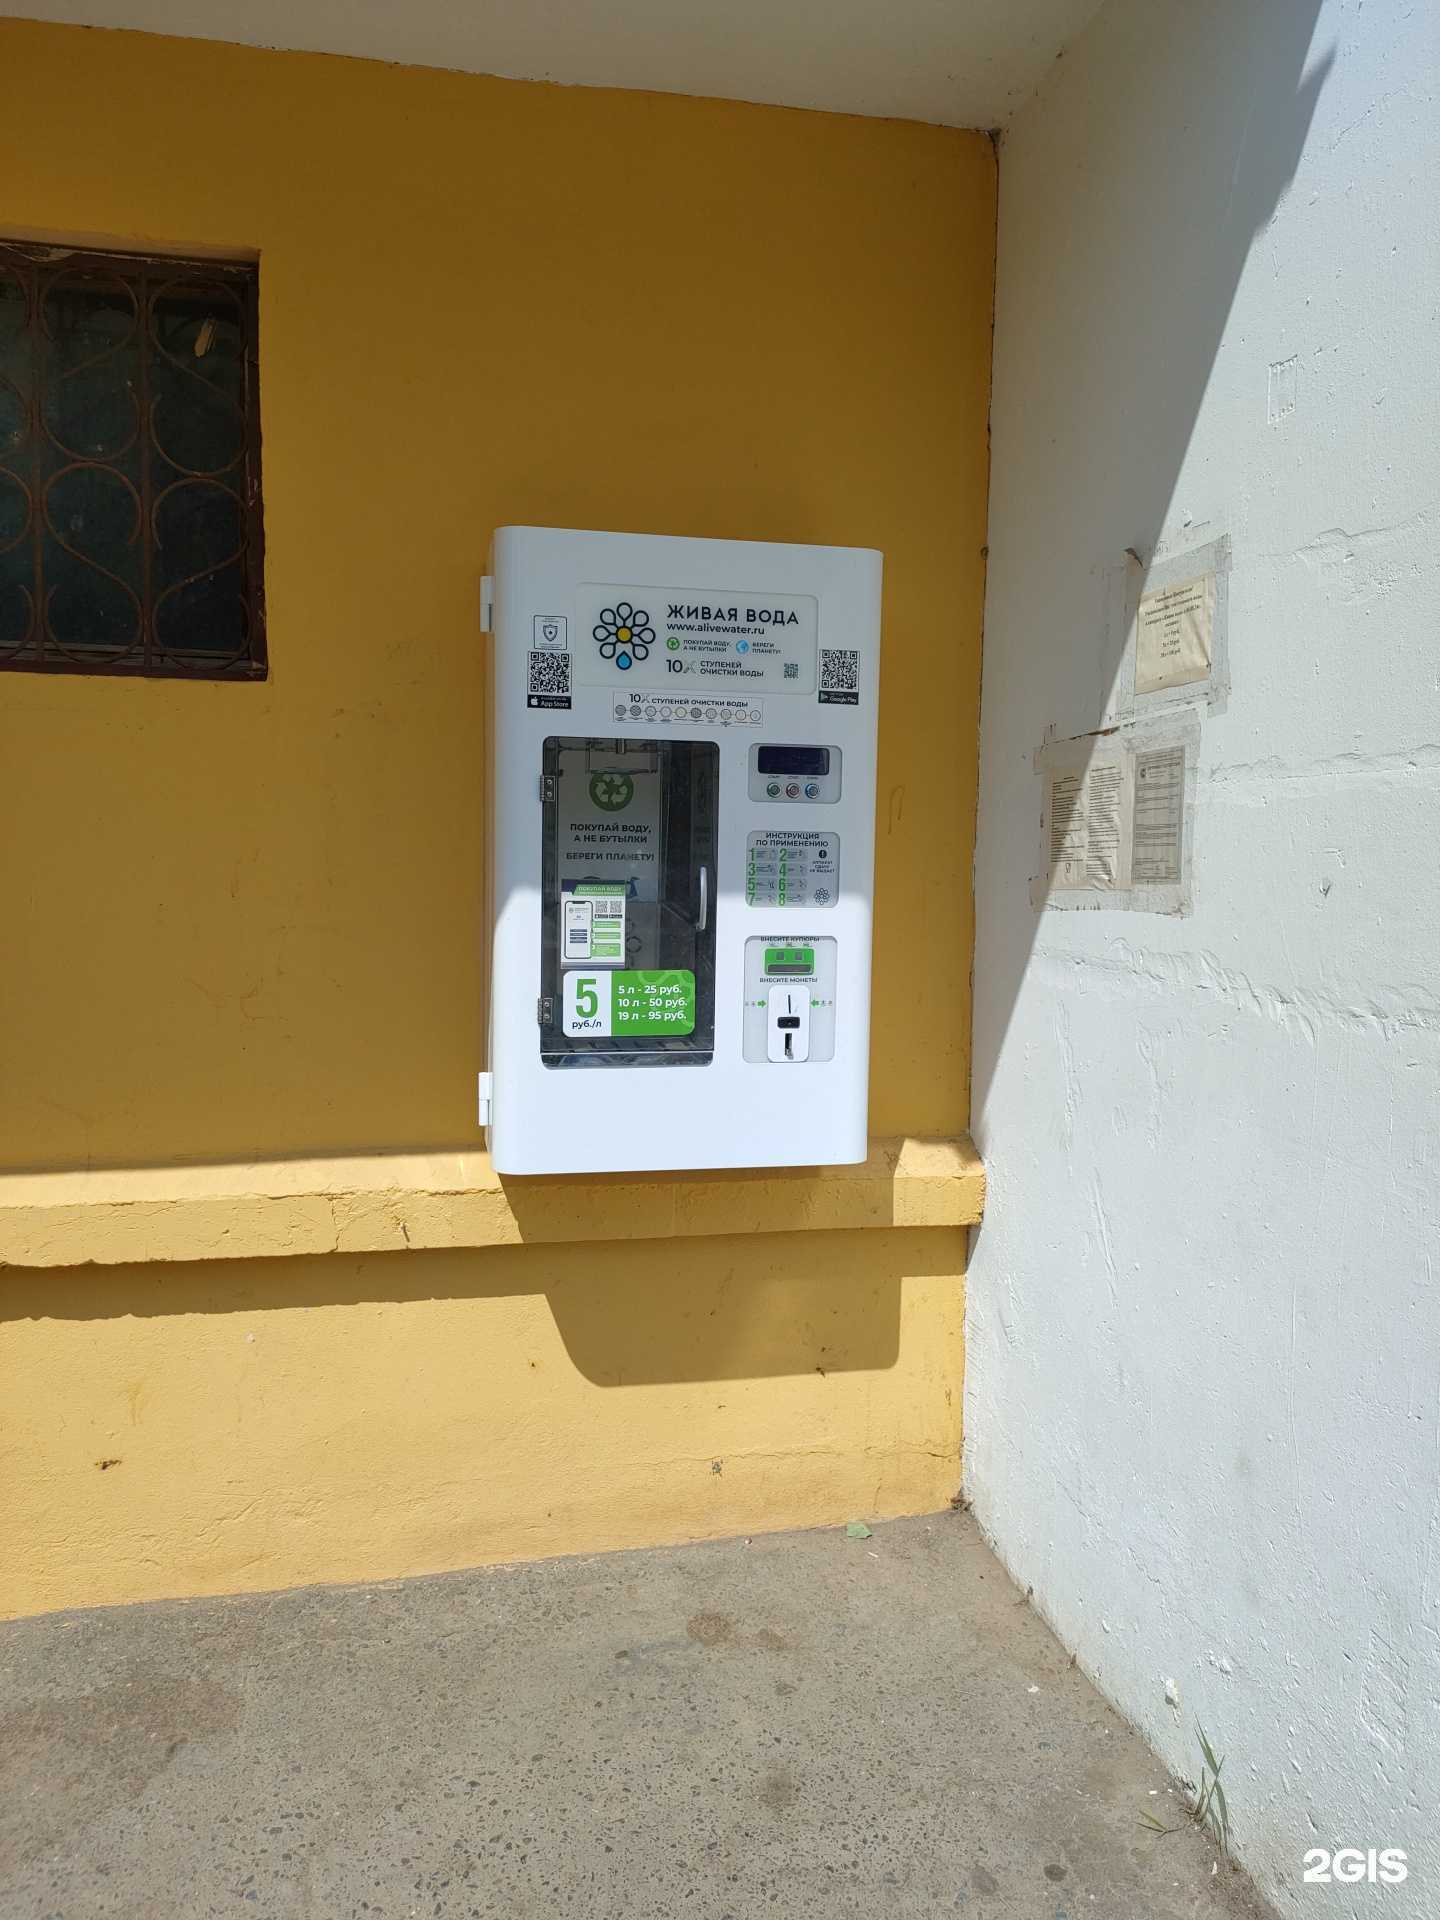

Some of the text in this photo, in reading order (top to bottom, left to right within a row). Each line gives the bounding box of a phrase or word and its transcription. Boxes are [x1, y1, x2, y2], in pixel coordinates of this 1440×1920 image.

[666, 604, 799, 626] ЖИВАЯ ВОДА
[666, 622, 765, 635] www.alivewater.ru
[700, 660, 742, 668] СТУПЕНЕЙ
[700, 668, 738, 676] ОЧИСТКИ
[651, 697, 689, 705] СТУПЕНЕЙ
[726, 700, 748, 708] ВОДЫ
[570, 821, 652, 834] ПОКУПАЙ ВОДУ,
[583, 835, 597, 843] НЕ
[599, 836, 648, 844] БУТЫЛКИ
[765, 832, 820, 840] ИНСТРУКЦИЯ
[769, 839, 829, 848] ПРИМЕНЕНИЮ
[566, 852, 603, 860] БЕРЕГИ
[617, 986, 625, 994] 5
[644, 986, 657, 994] 25
[659, 984, 683, 996] руб.
[575, 978, 598, 1019] 5
[618, 998, 630, 1007] 10
[631, 999, 640, 1007] л
[649, 998, 662, 1007] 50
[664, 997, 688, 1010] руб.
[618, 1011, 630, 1020] 19
[631, 1012, 639, 1020] л
[648, 1011, 662, 1020] 95
[663, 1010, 687, 1022] руб.
[571, 1019, 602, 1030] руб./л
